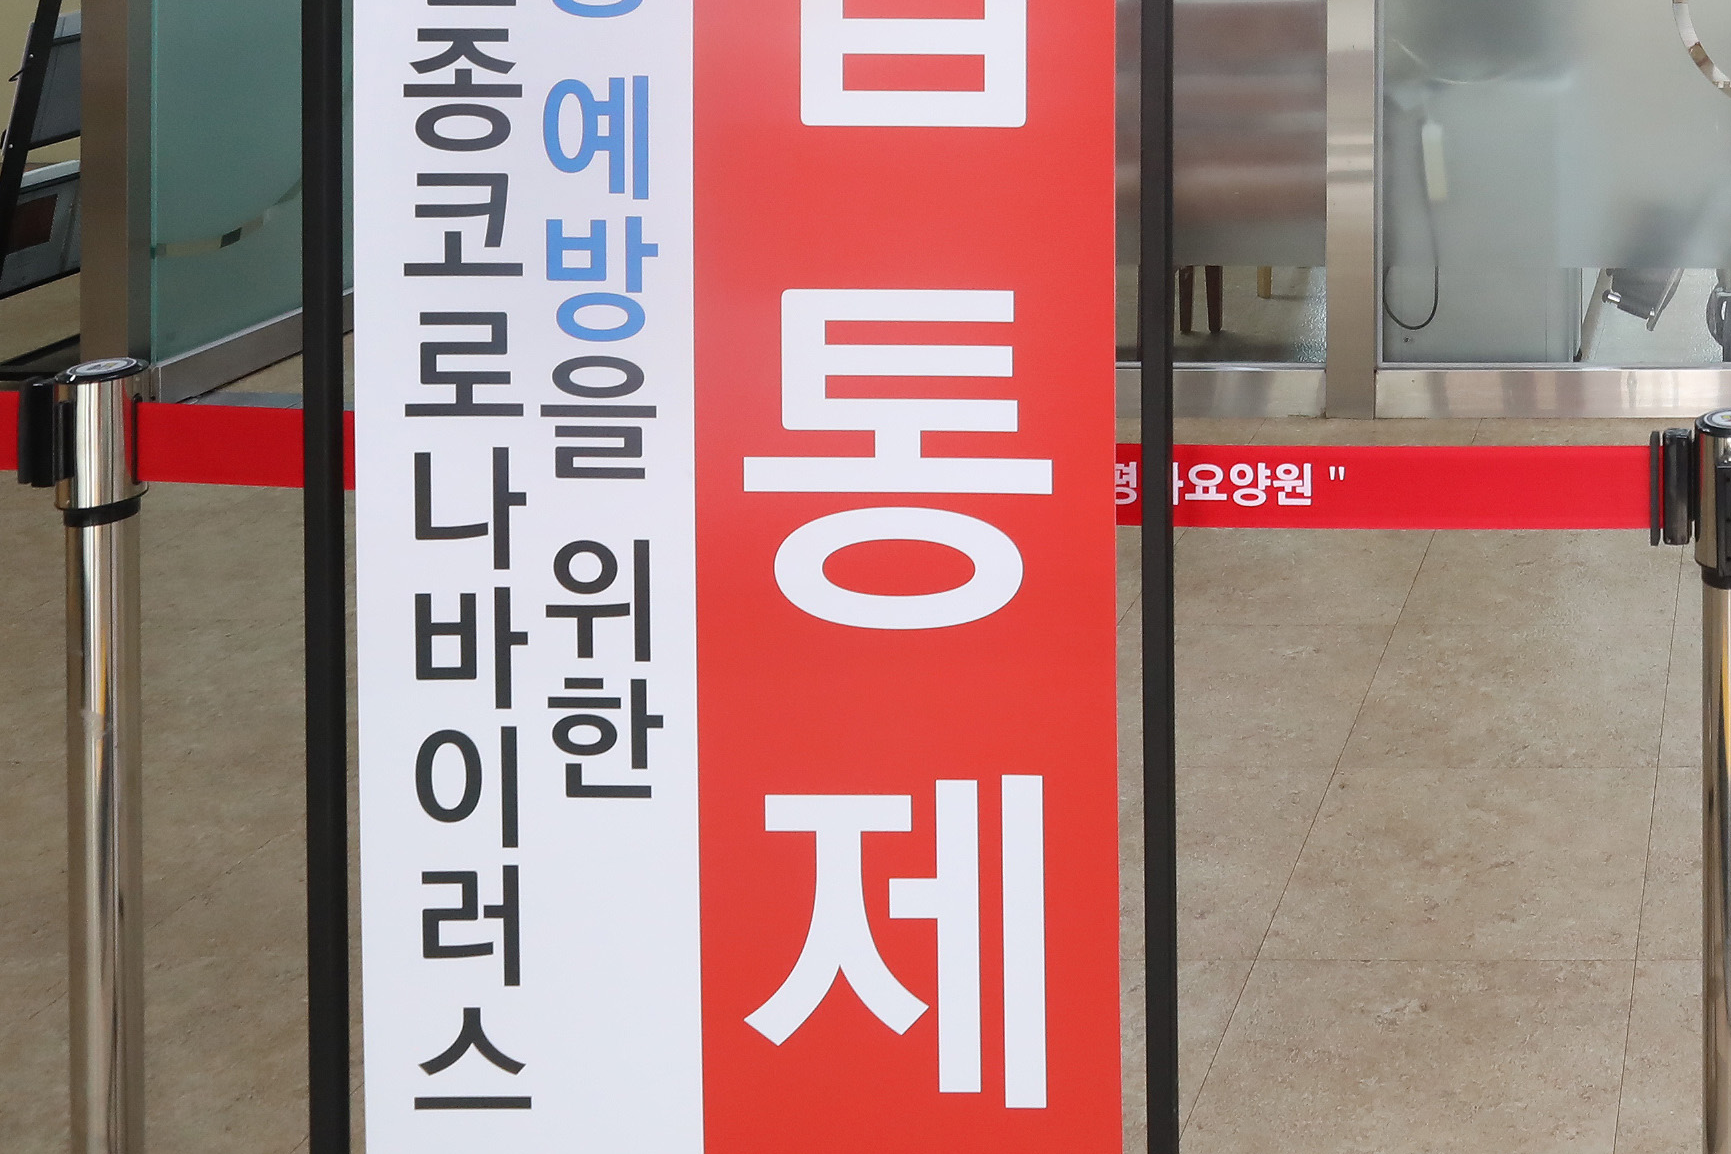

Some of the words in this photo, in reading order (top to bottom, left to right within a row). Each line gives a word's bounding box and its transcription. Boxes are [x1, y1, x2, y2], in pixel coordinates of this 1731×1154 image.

[541, 76, 658, 479] 예방을
[1115, 461, 1312, 507] 평요양원
[545, 539, 663, 799] 위한
